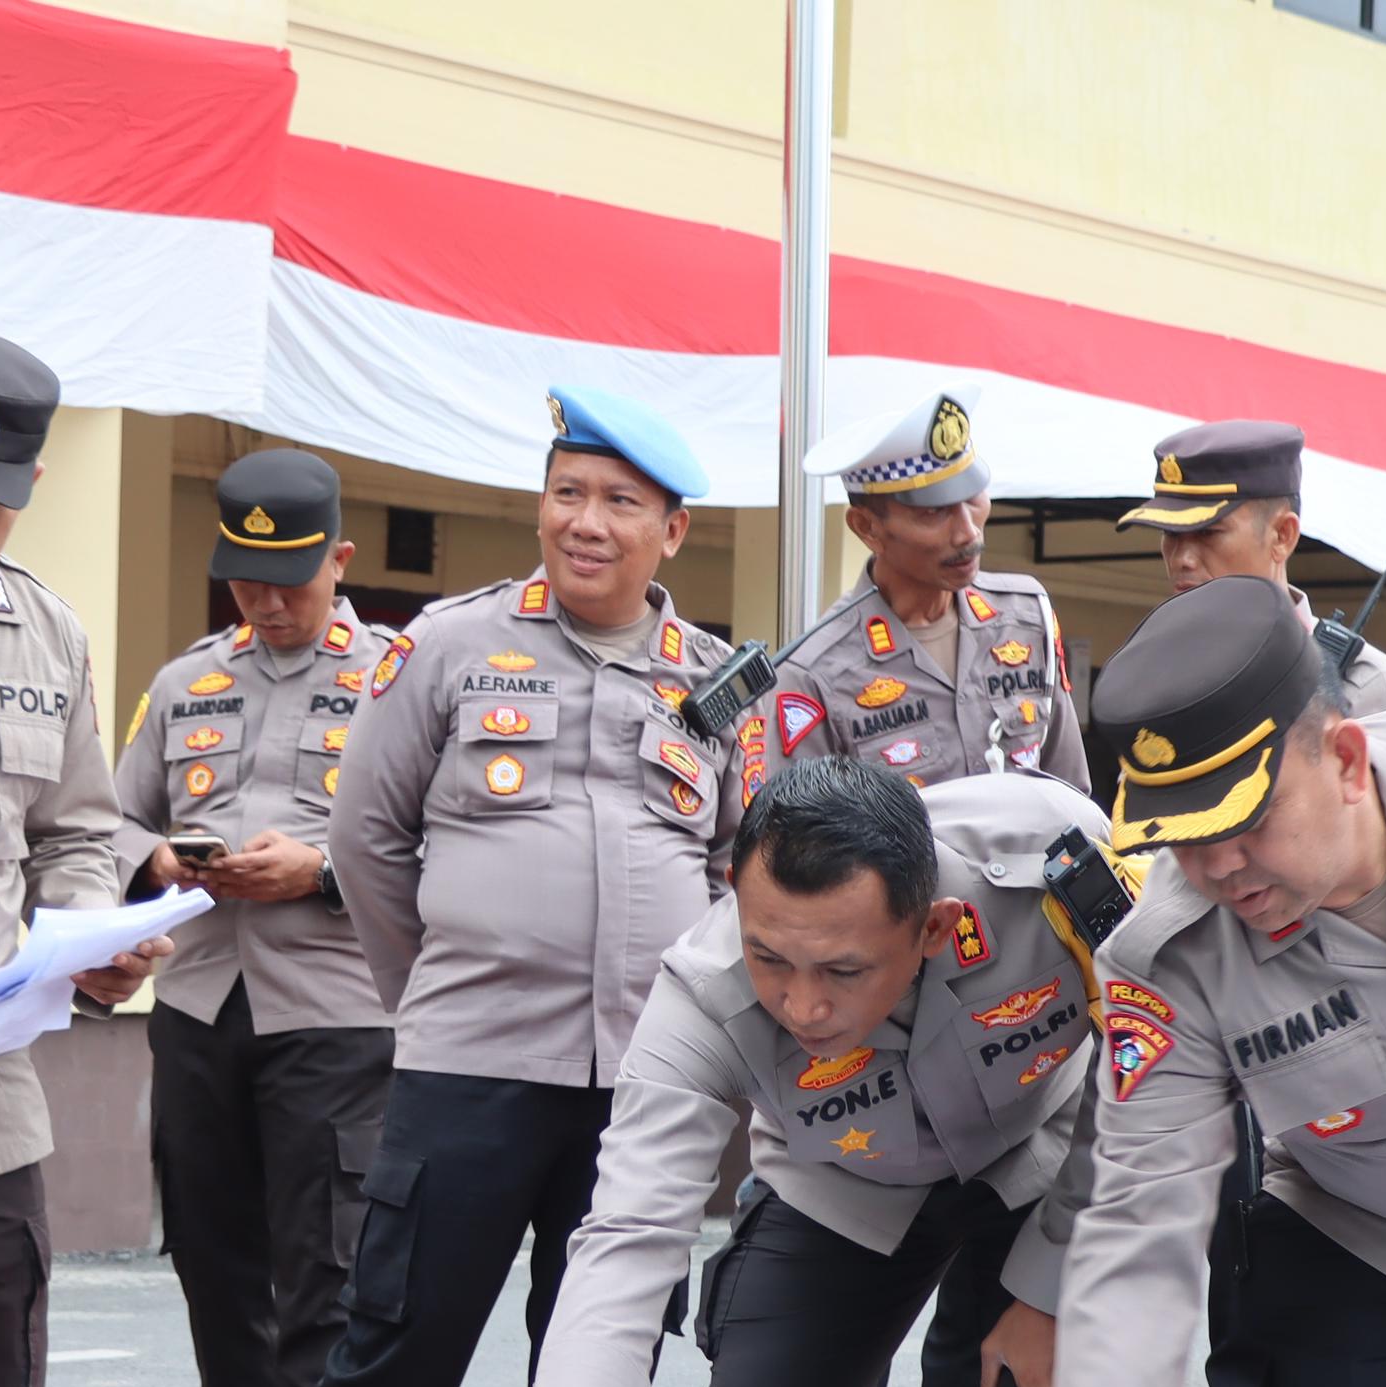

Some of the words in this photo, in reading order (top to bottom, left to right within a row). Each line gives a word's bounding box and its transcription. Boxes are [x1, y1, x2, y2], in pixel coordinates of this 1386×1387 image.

[981, 1003, 1078, 1067] POLRI
[1234, 990, 1359, 1067] FIRMAN
[797, 1071, 897, 1128] YON.E
